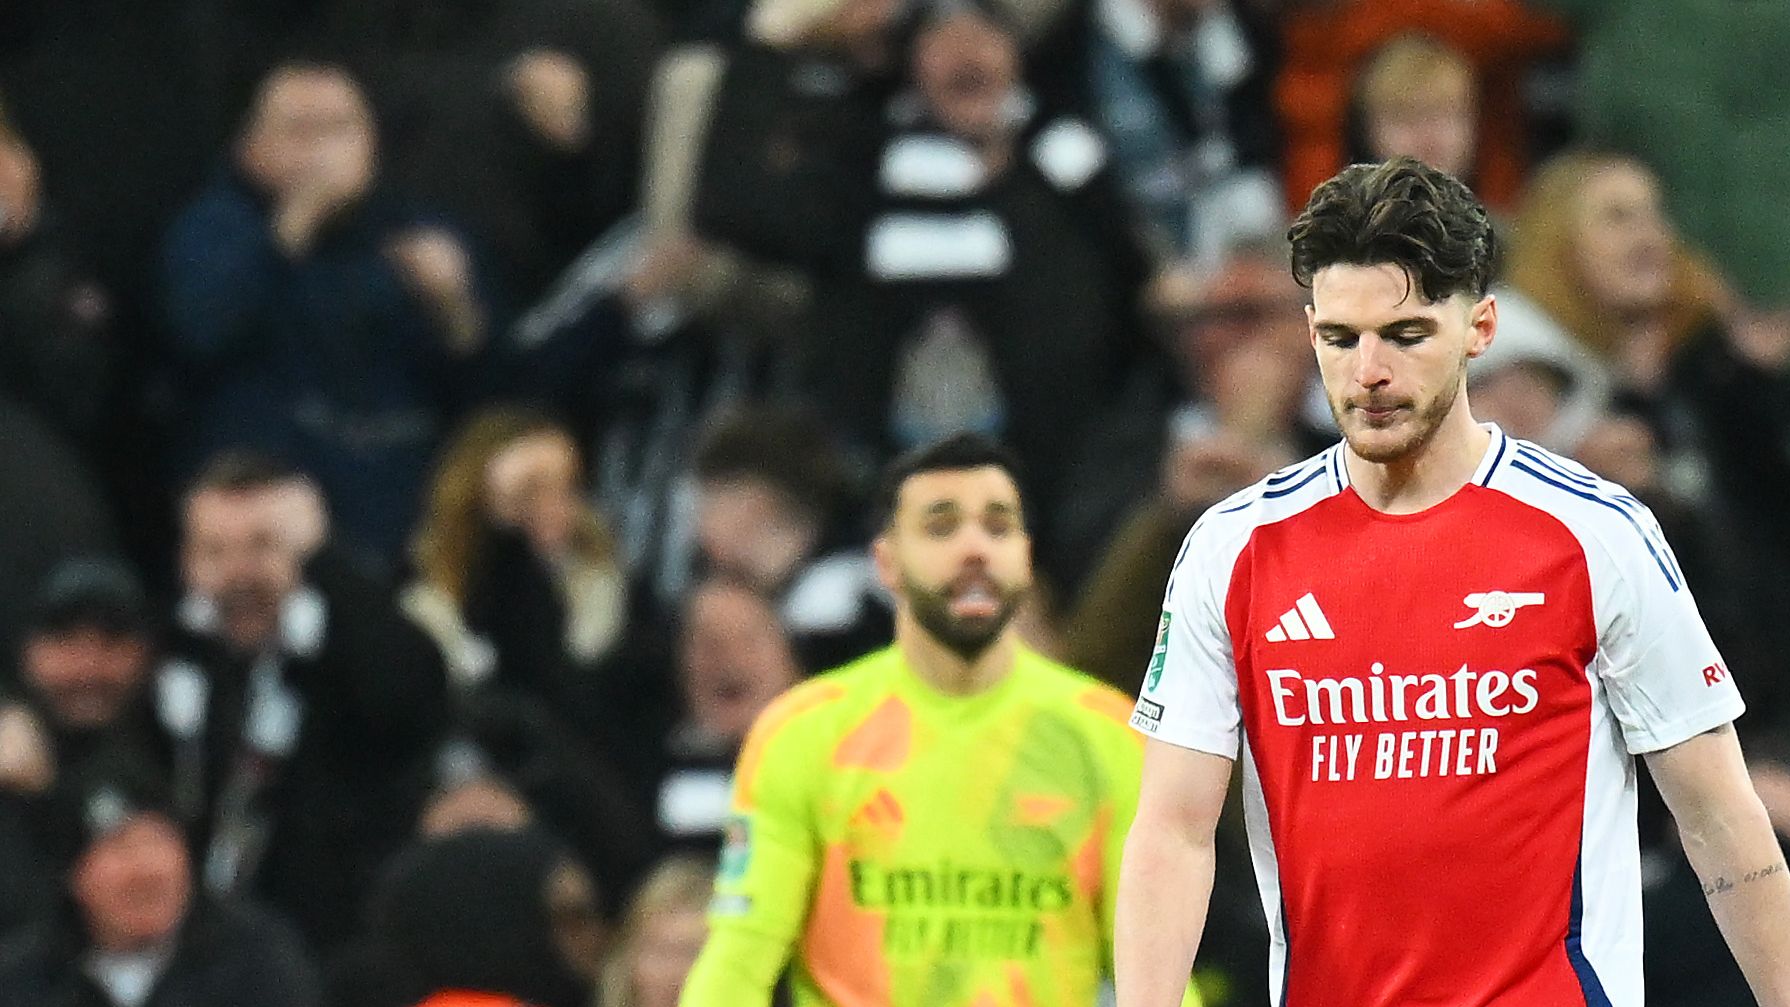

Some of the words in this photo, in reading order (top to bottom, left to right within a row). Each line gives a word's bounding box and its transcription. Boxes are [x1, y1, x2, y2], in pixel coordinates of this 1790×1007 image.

[1265, 662, 1539, 727] Emirates
[1311, 734, 1363, 782] FLY
[1374, 728, 1499, 780] BETTER
